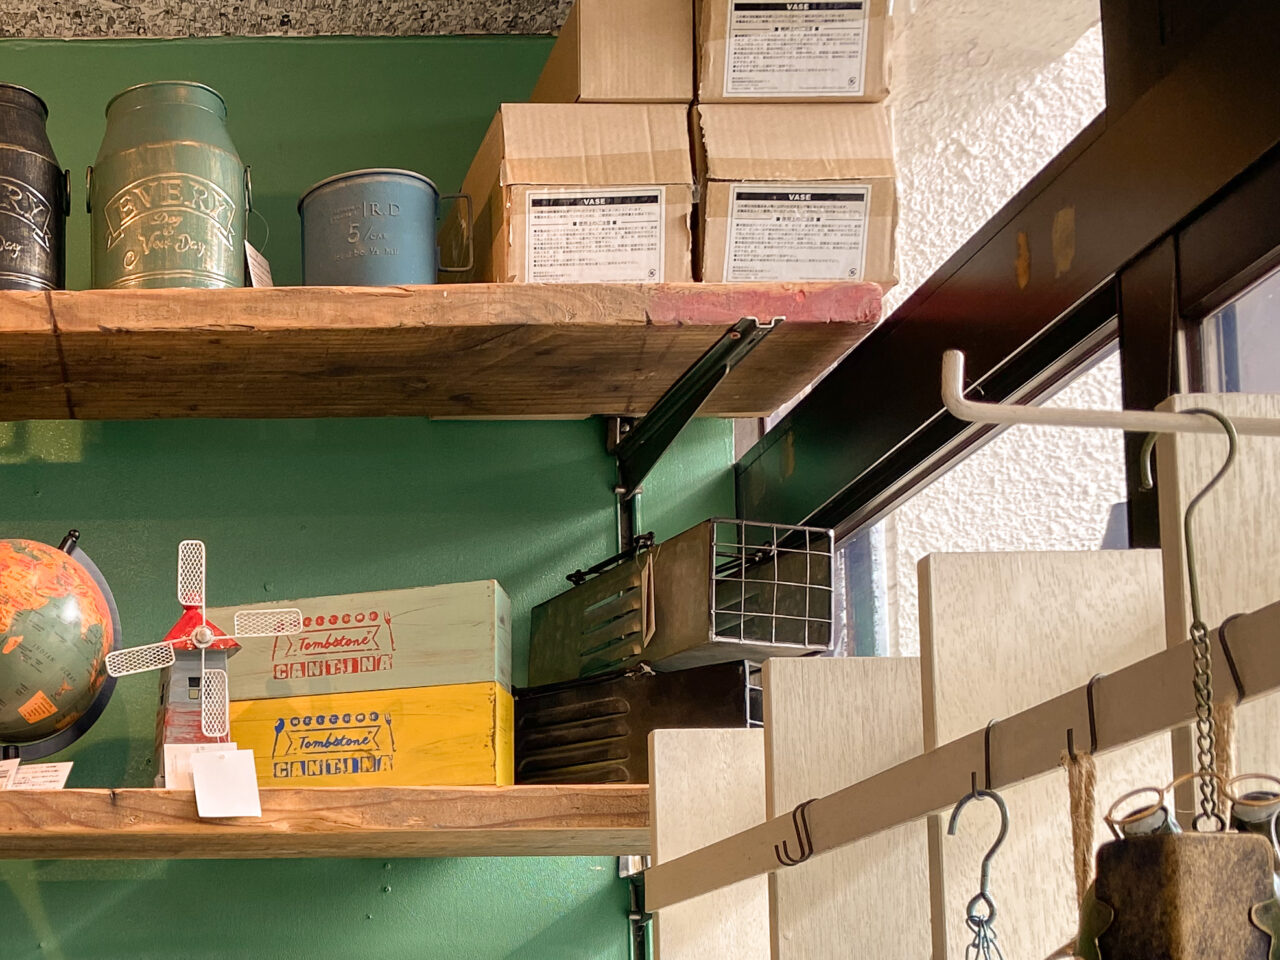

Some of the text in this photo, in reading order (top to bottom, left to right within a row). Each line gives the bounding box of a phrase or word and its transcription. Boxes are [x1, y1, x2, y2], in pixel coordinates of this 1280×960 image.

[114, 179, 229, 226] EVERY
[583, 198, 606, 206] VASE
[788, 193, 812, 201] VASE
[175, 233, 206, 258] Day
[298, 633, 371, 652] Tombstone
[273, 653, 393, 680] CANTINA
[298, 732, 371, 750] Tombstone
[273, 754, 393, 778] CANTINA
